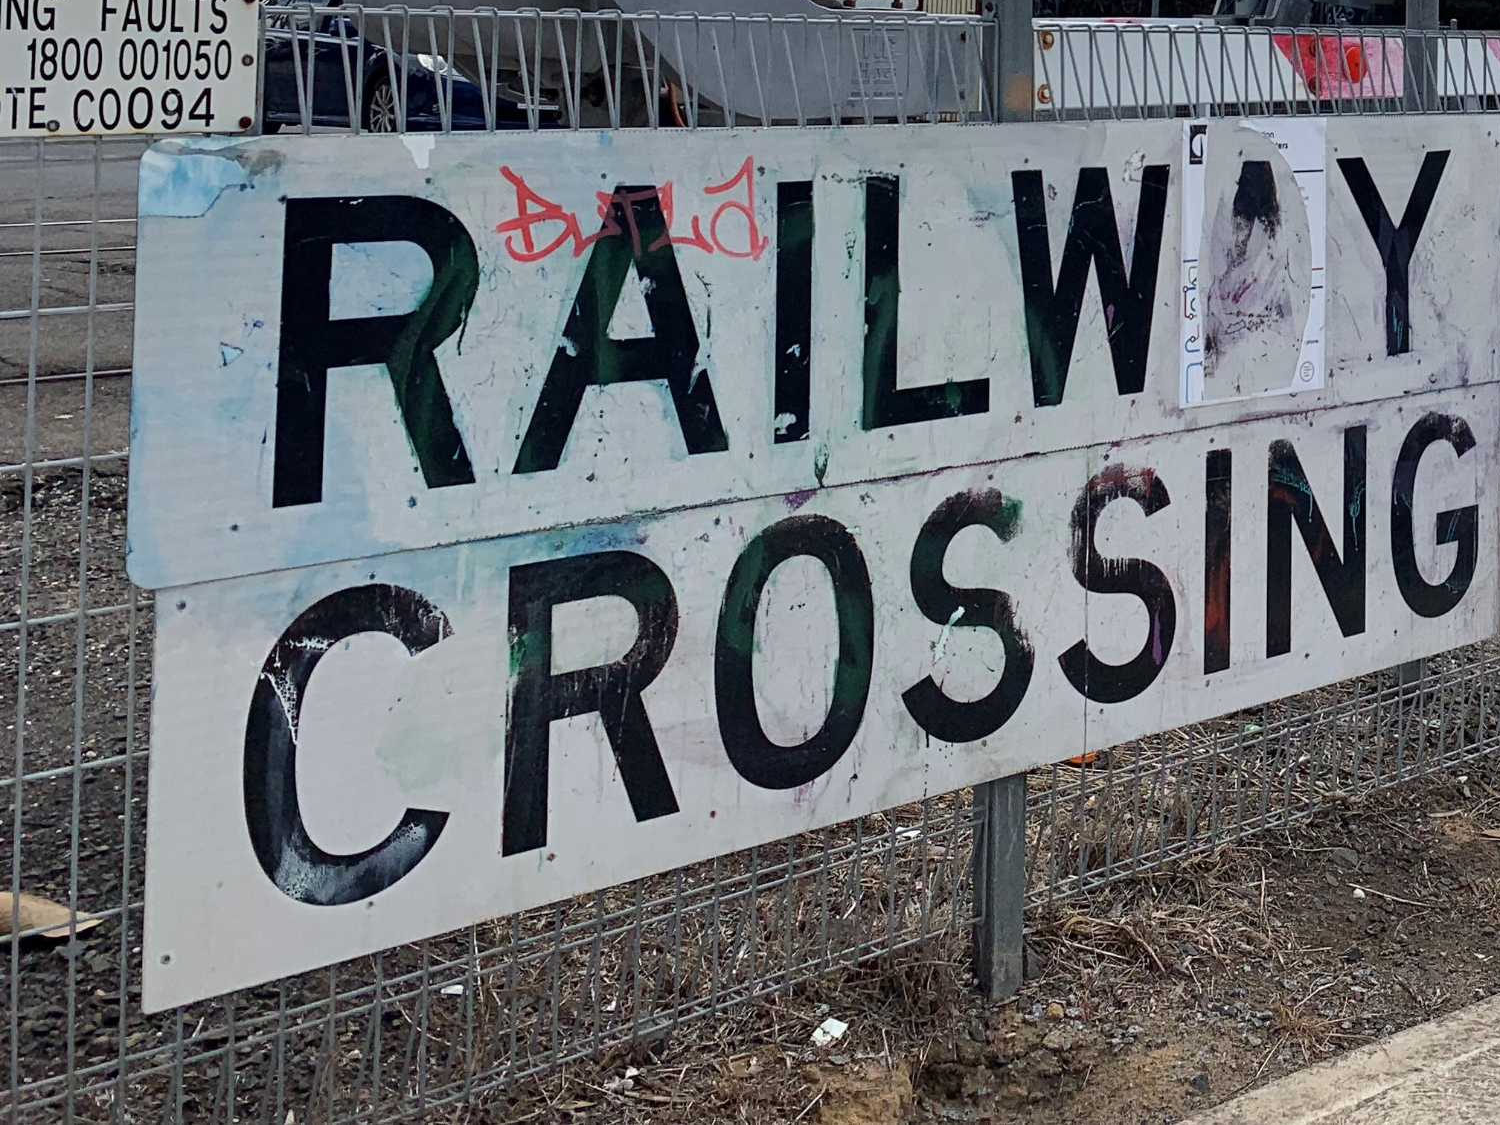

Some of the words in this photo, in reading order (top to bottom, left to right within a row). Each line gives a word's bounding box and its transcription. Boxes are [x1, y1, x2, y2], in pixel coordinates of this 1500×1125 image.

[27, 38, 102, 80] 1800
[119, 39, 232, 81] 001050
[242, 411, 1479, 906] CROSSING
